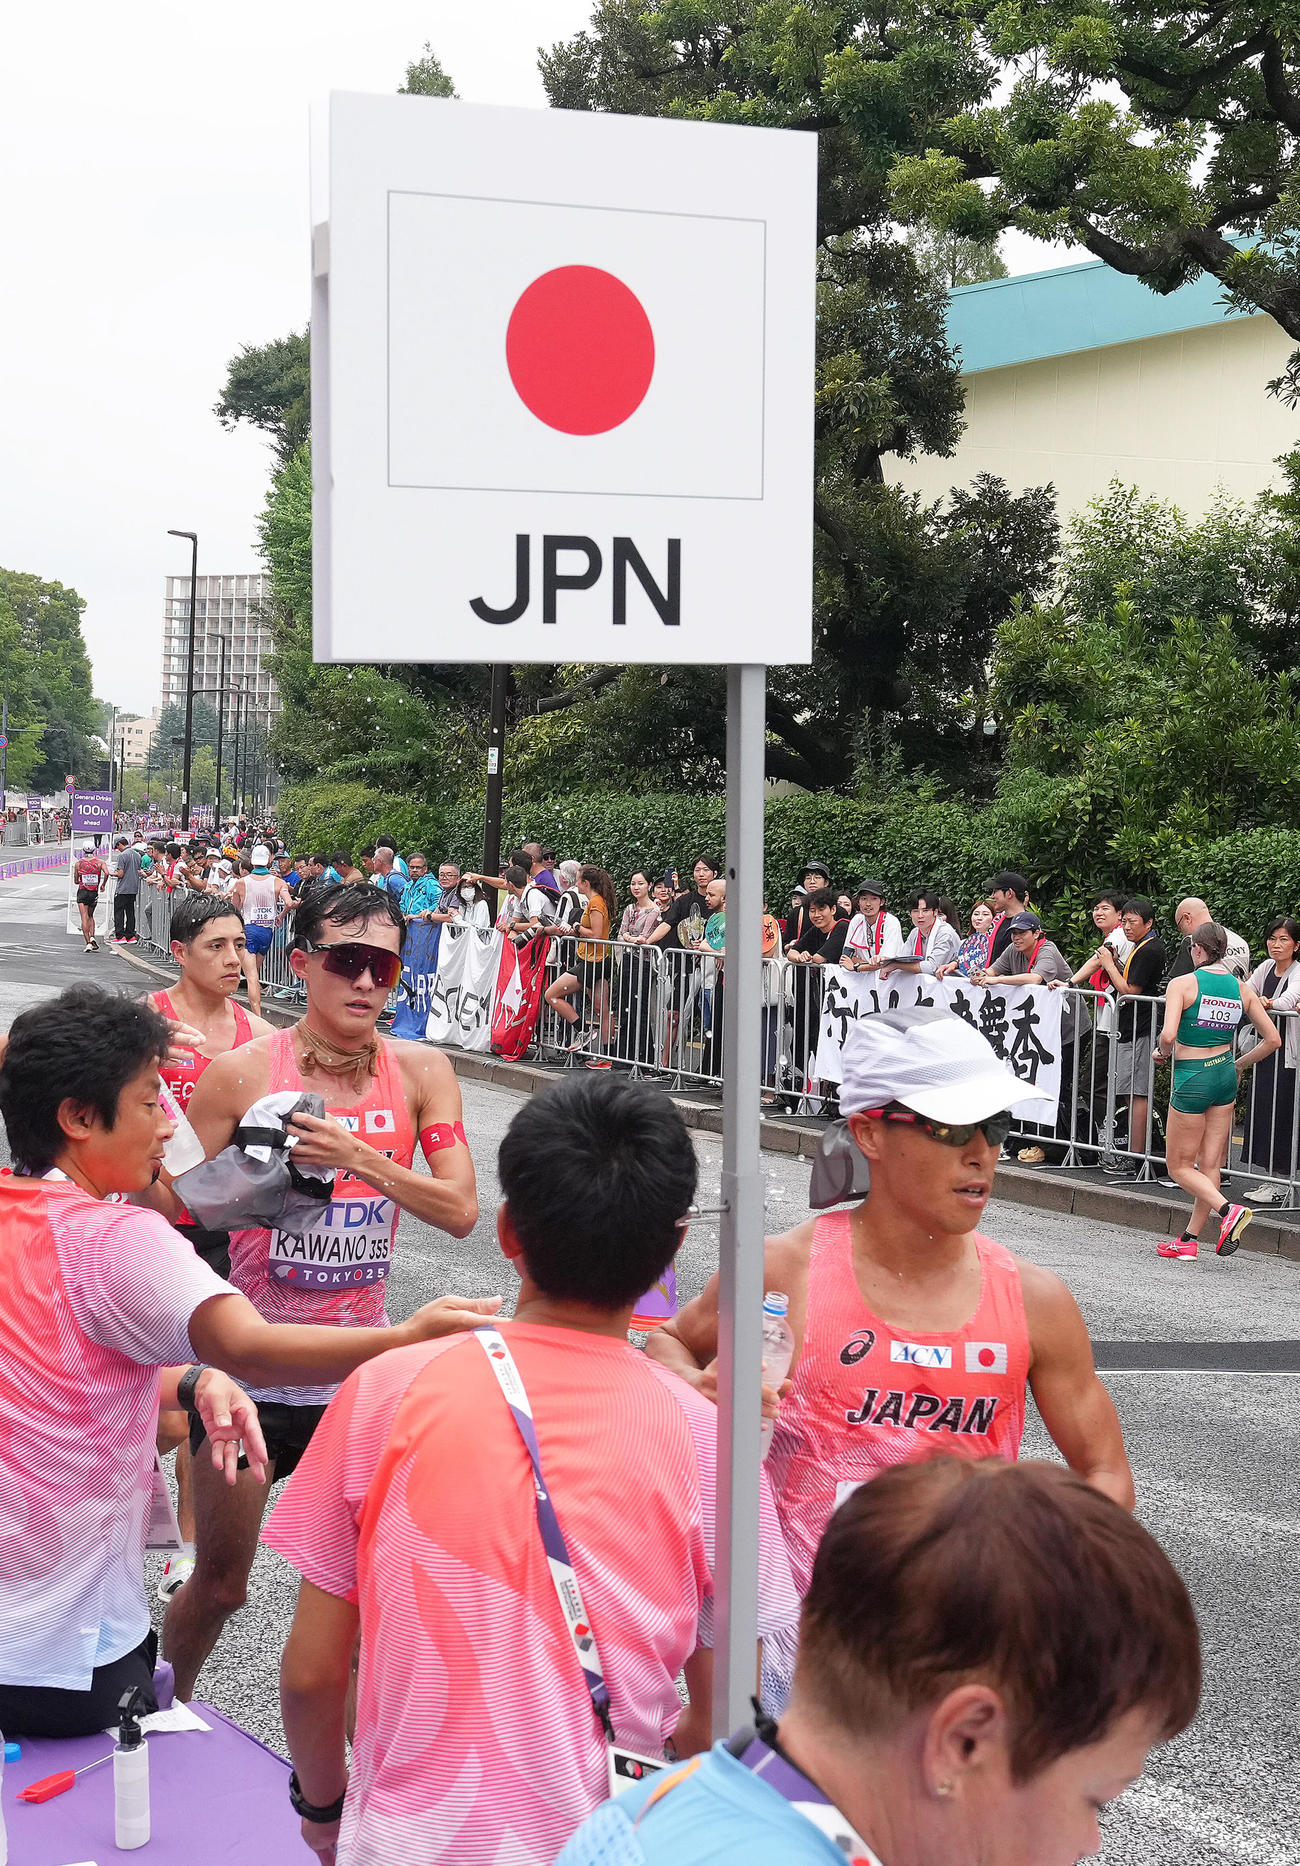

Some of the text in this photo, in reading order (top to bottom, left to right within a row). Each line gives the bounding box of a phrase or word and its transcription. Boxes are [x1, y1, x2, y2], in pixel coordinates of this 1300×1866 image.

[469, 533, 682, 626] JPN
[74, 793, 112, 802] General Drinks
[77, 804, 109, 817] 100M
[1223, 946, 1246, 957] ONY
[1201, 998, 1242, 1010] HONDA
[1209, 1009, 1231, 1022] 103
[430, 1131, 441, 1143] KT
[323, 1200, 389, 1229] TDK
[275, 1230, 389, 1264] KAWANO 355
[893, 1344, 950, 1367] ACN
[846, 1387, 1000, 1435] JAPAN
